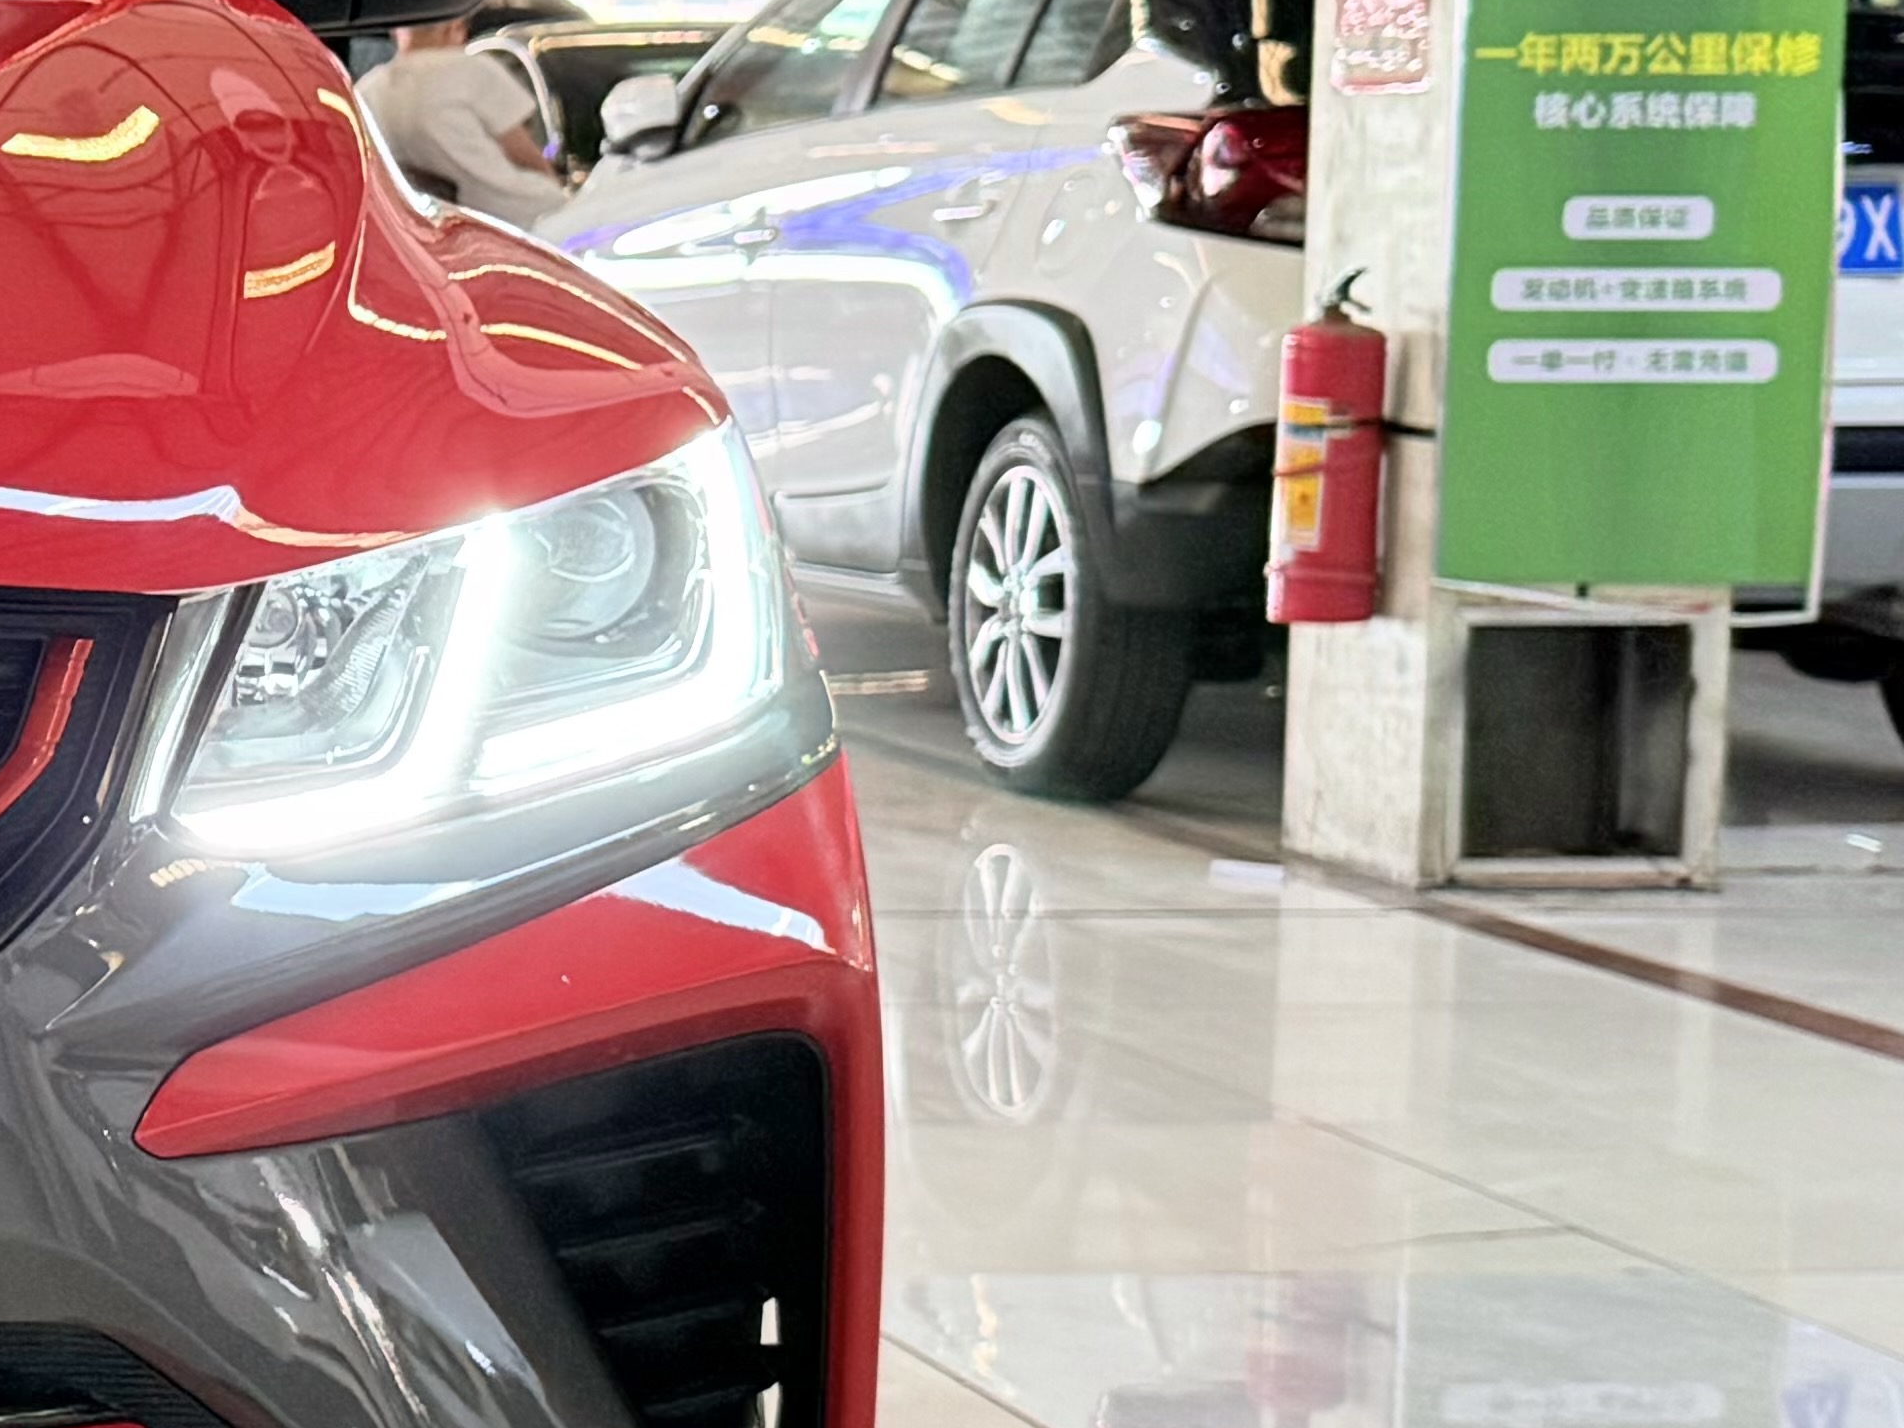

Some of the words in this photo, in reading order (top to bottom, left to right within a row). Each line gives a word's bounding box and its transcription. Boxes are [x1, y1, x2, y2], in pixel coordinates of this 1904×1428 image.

[1474, 31, 1822, 77] 一年两万公里保修
[1534, 90, 1758, 130] 核心系统保障
